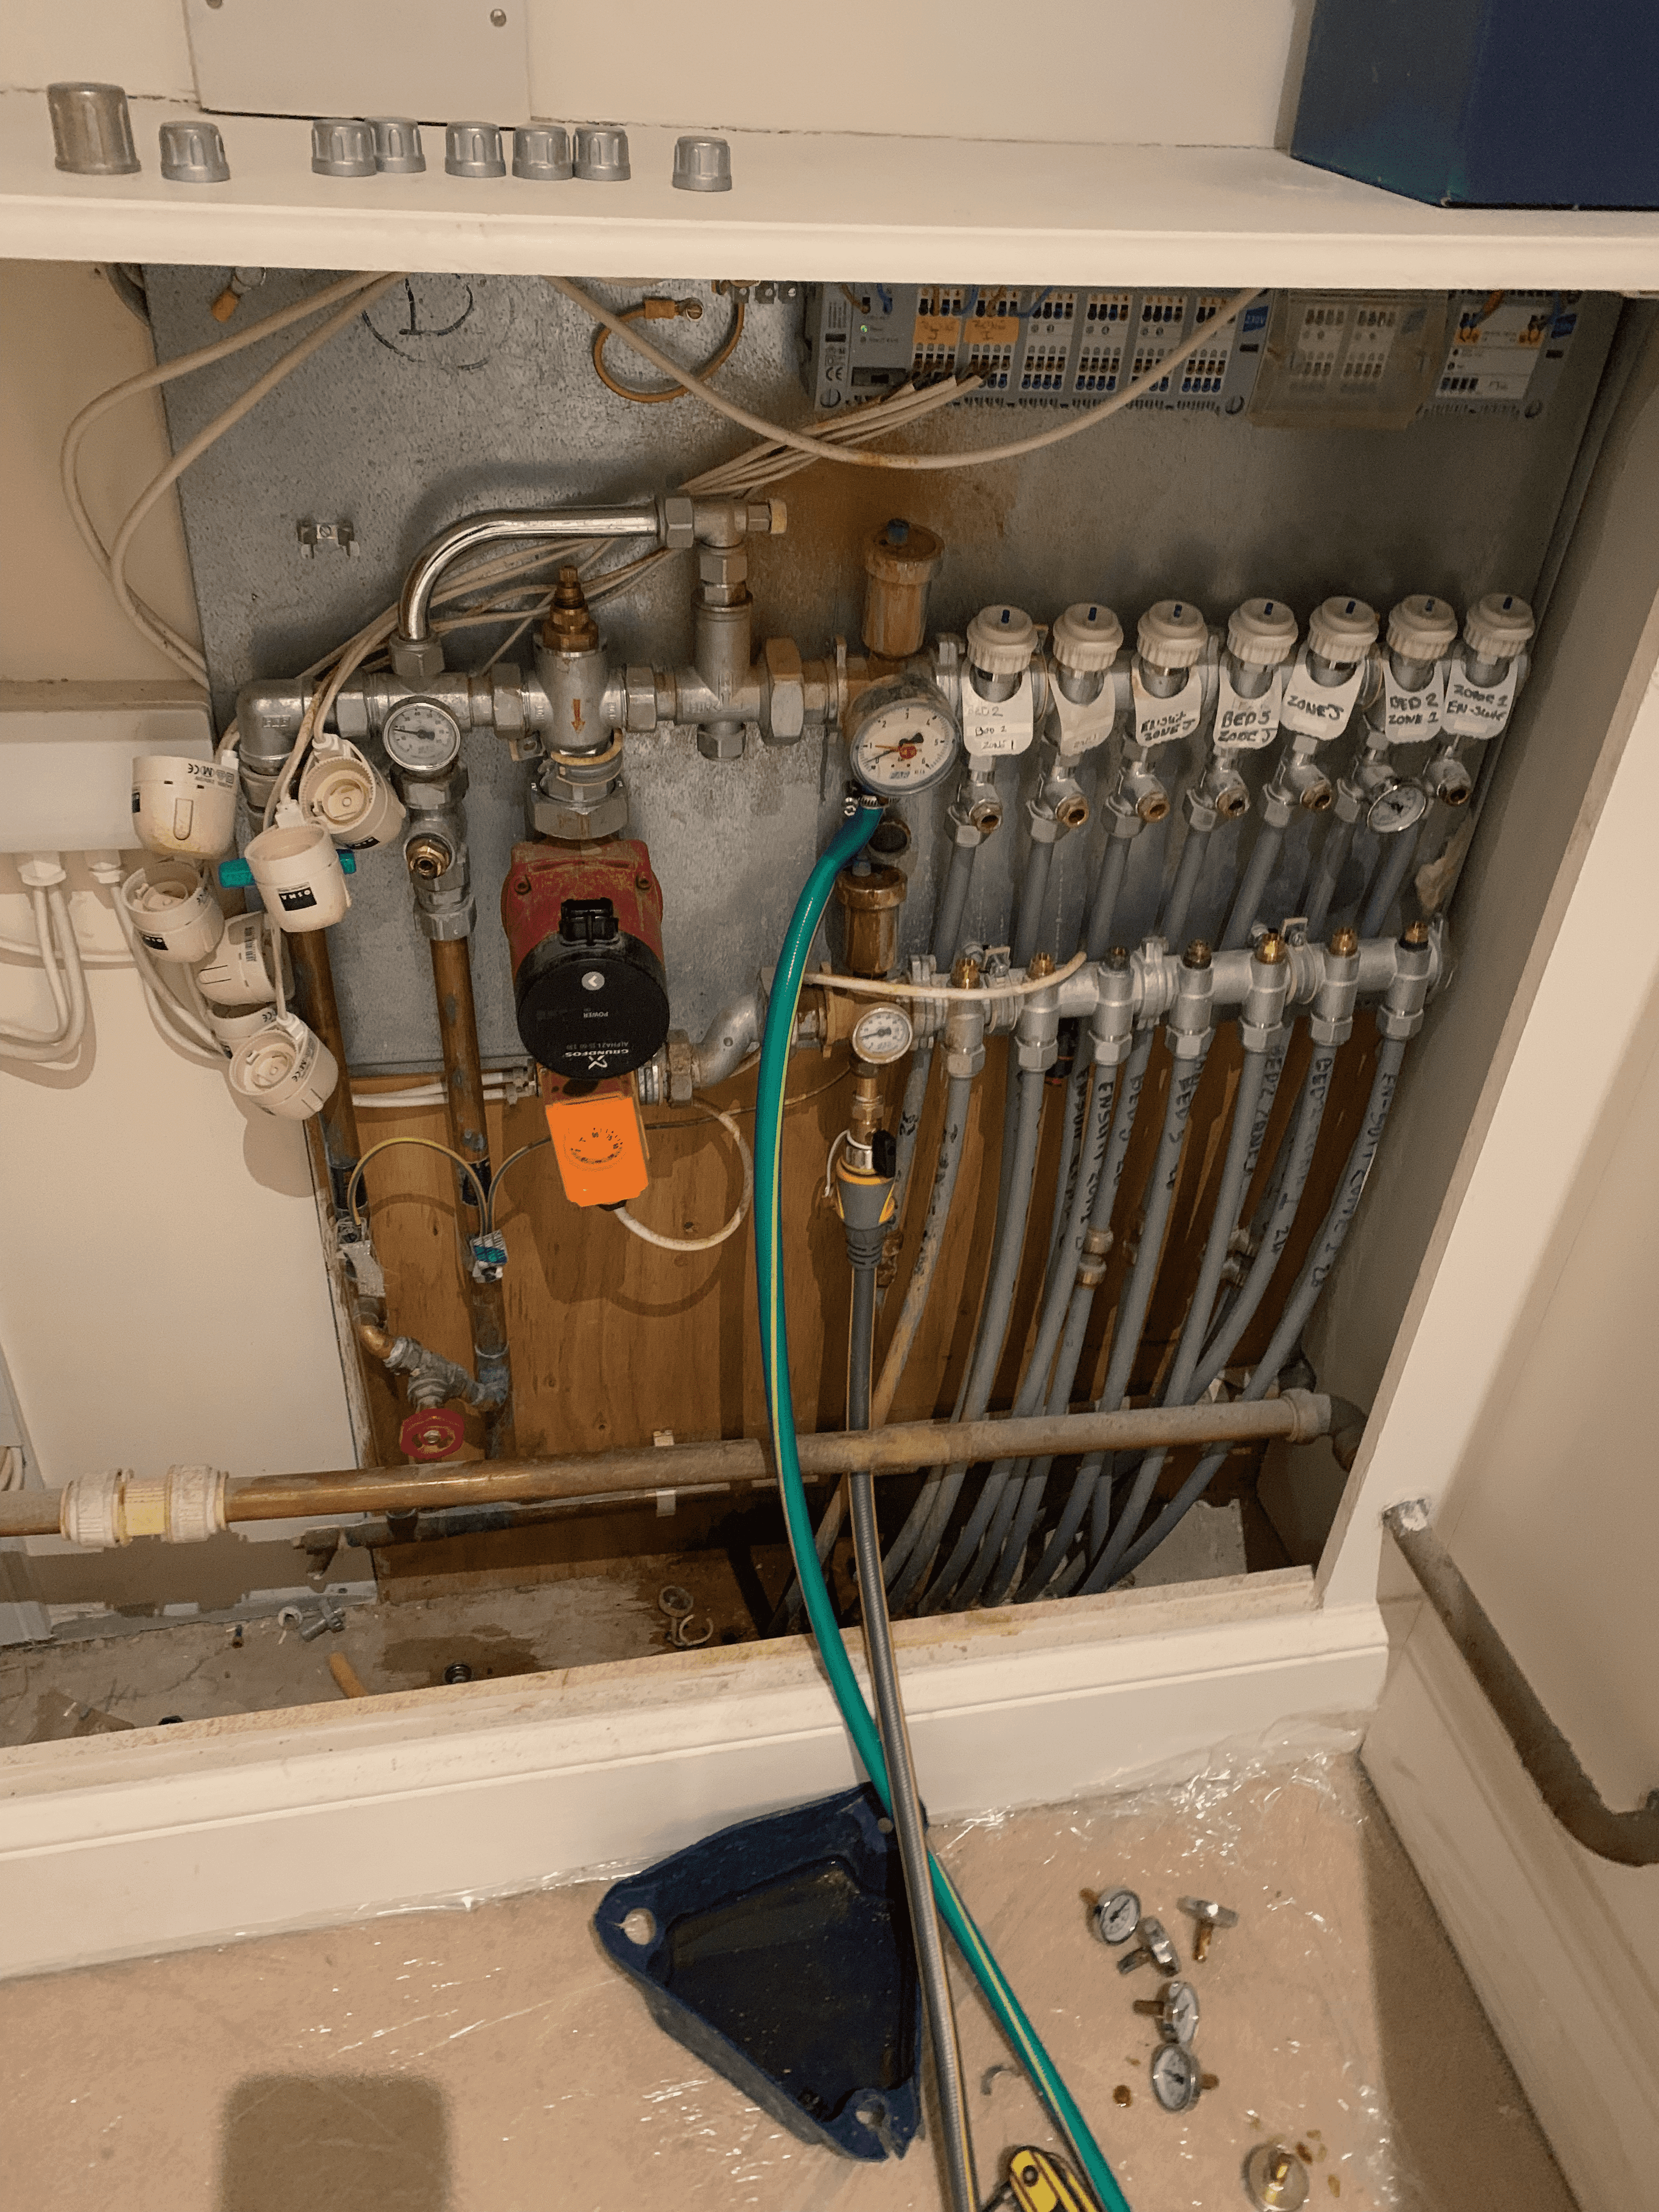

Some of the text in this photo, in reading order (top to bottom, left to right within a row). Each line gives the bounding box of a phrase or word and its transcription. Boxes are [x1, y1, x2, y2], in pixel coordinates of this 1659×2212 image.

[1425, 692, 1438, 707] 2
[992, 706, 1003, 716] 2
[1221, 711, 1257, 728] BED
[565, 1048, 629, 1057] GRUNDFOS
